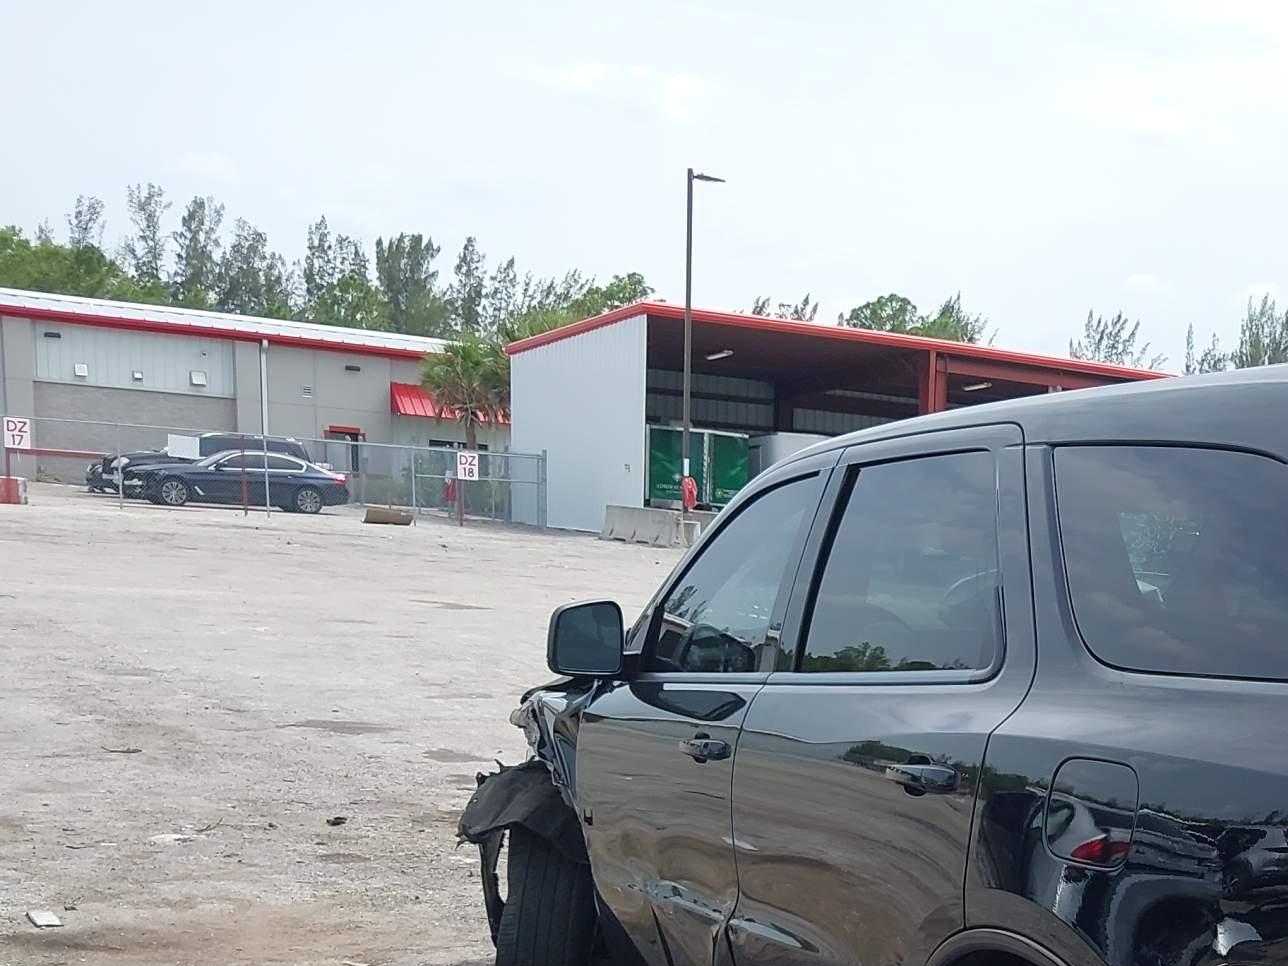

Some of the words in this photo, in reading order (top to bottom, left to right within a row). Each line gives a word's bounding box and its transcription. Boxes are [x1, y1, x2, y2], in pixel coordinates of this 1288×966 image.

[6, 420, 28, 433] DZ
[11, 434, 24, 446] 17
[459, 455, 477, 466] DZ
[463, 467, 475, 478] 18
